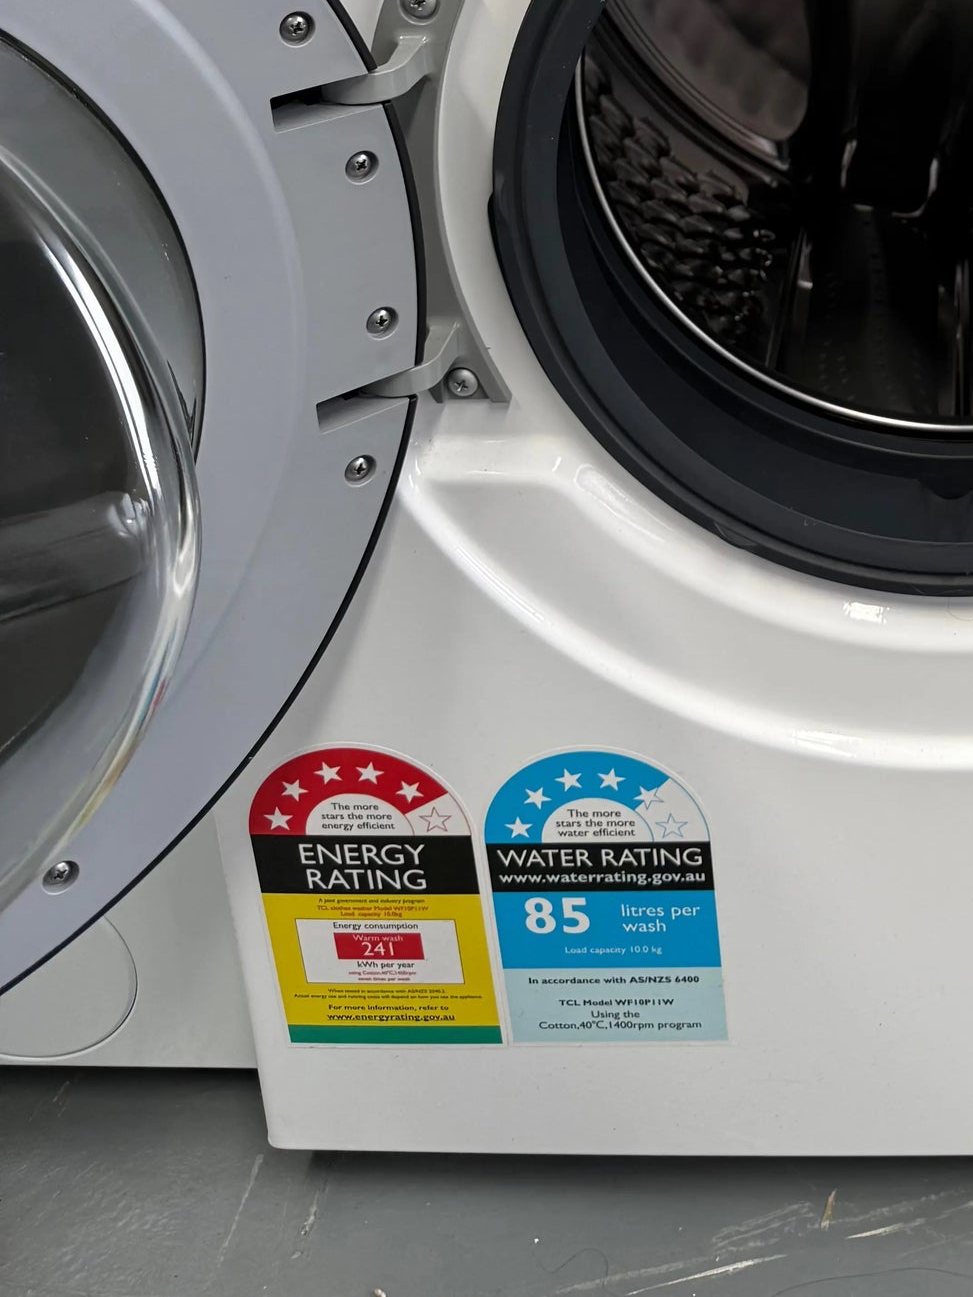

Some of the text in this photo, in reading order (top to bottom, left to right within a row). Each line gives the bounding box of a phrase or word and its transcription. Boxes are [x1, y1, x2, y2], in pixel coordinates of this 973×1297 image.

[331, 802, 350, 811] The
[348, 812, 364, 820] the
[567, 808, 622, 818] The more
[322, 822, 395, 831] energy efficient
[556, 818, 636, 828] stars the more
[558, 828, 636, 838] water efficient
[298, 843, 425, 866] ENERGY
[497, 847, 704, 868] WATER RATING
[305, 869, 428, 890] RATING
[498, 870, 706, 886] www.waterrating.gov.au
[524, 896, 591, 934] 85
[621, 904, 700, 920] litres per
[333, 922, 419, 930] Energy consumption
[622, 920, 667, 933] wash
[352, 934, 404, 942] Warm wash
[361, 941, 395, 957] 241
[564, 946, 662, 956] Load capacity 10.0 kg
[356, 960, 415, 970] kWh per year
[528, 976, 700, 985] In accordance with AS/NZS 6400
[583, 998, 613, 1006] Model
[615, 998, 675, 1006] WF10P11W
[368, 1004, 417, 1012] information,
[327, 1013, 456, 1022] www.energyrating.gov.au
[591, 1010, 640, 1020] Using the
[658, 1022, 702, 1031] program
